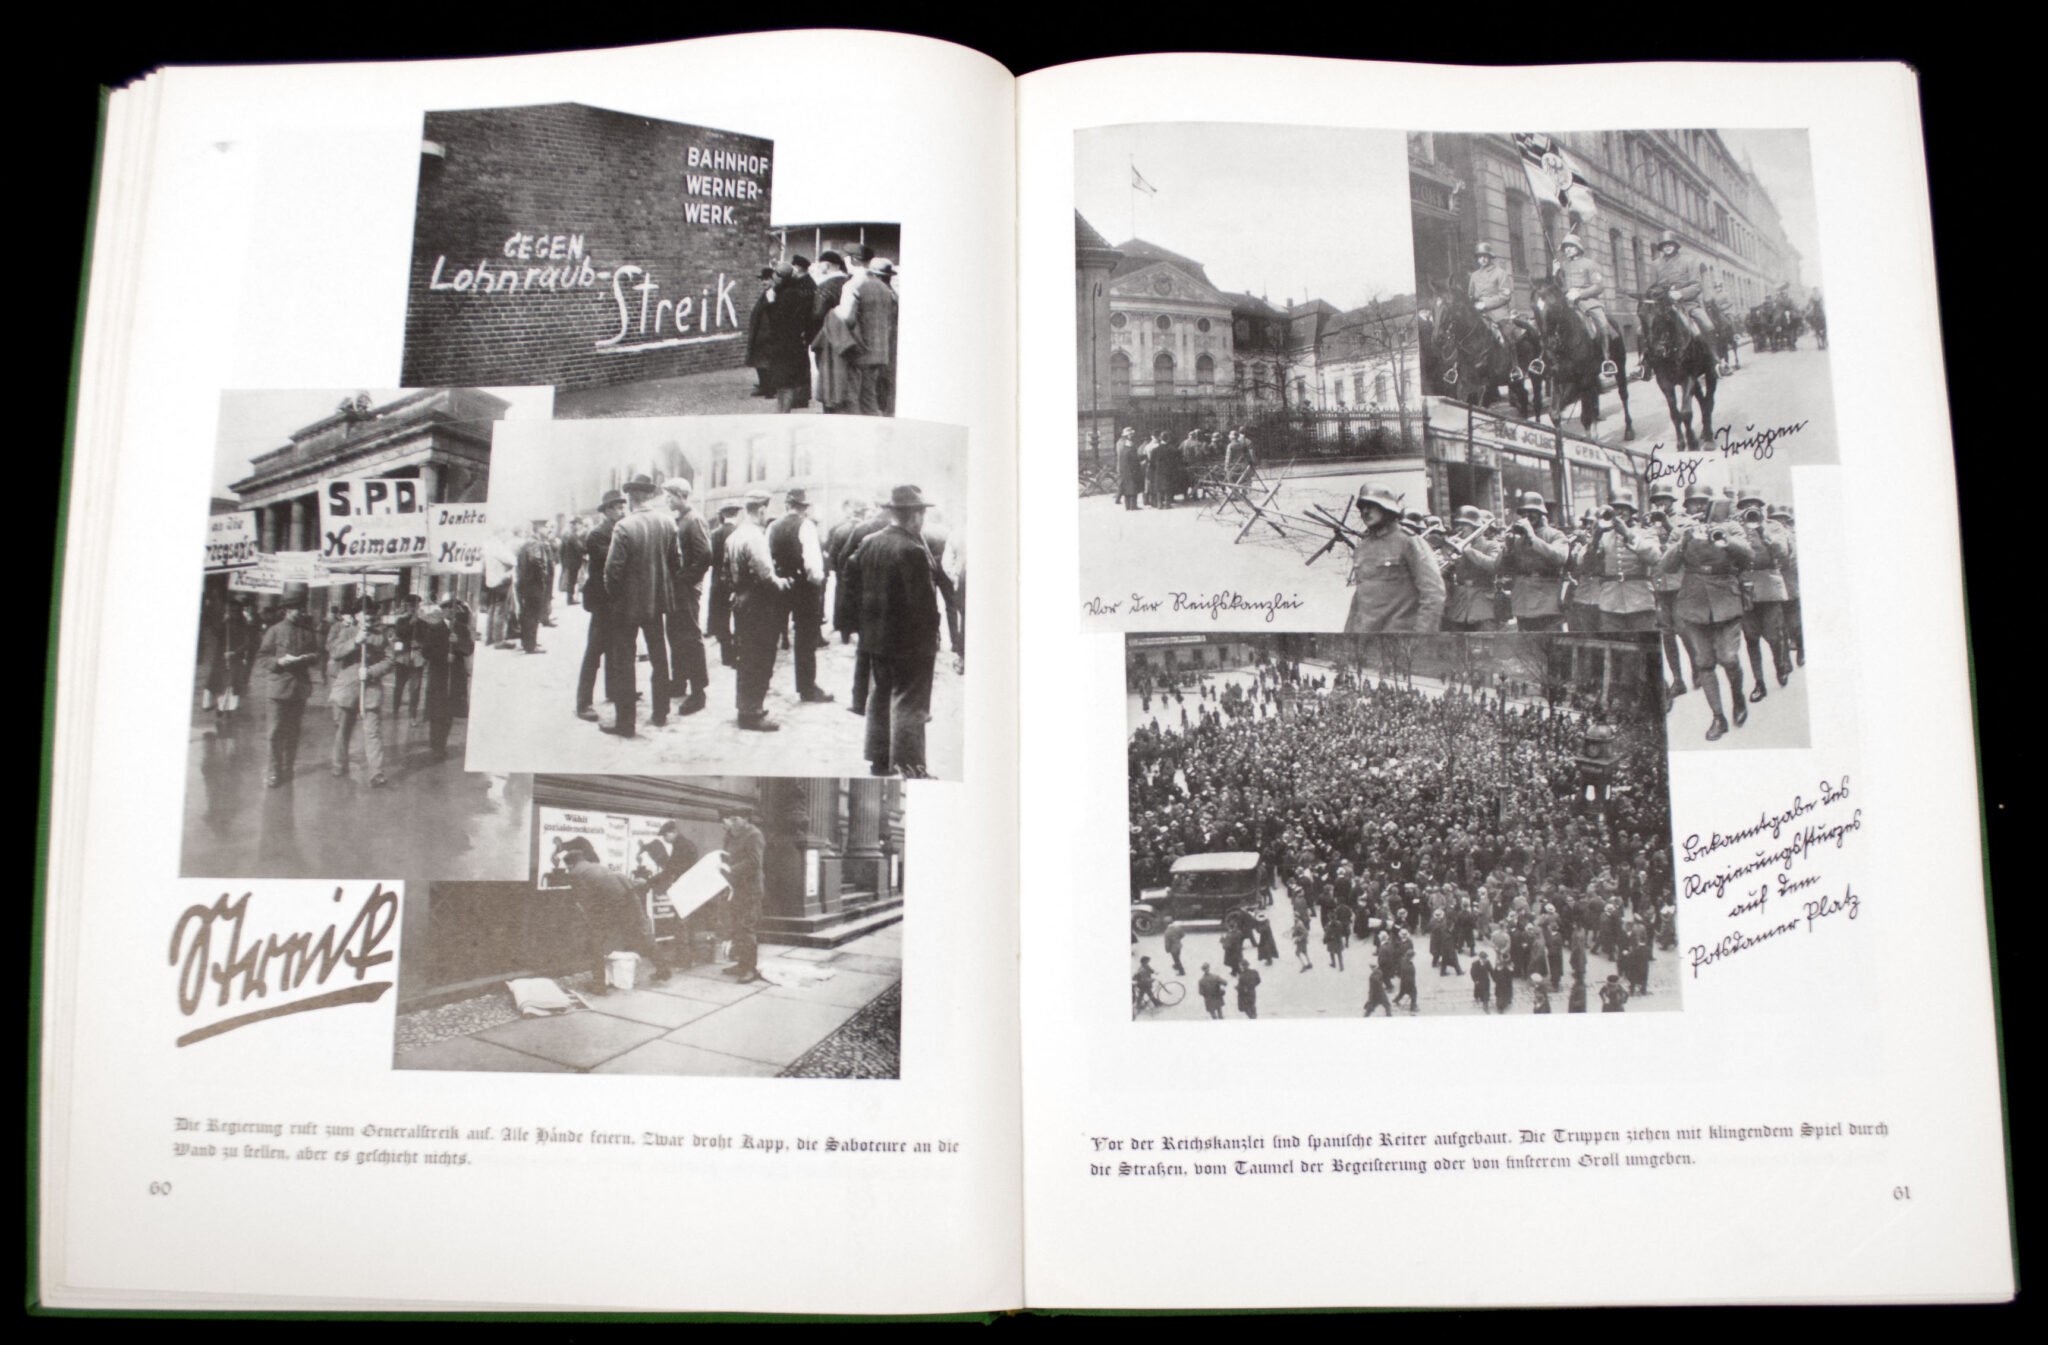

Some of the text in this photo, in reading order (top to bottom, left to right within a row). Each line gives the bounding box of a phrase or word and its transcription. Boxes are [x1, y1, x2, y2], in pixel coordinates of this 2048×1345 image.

[687, 146, 769, 176] BAHNHOF
[685, 174, 764, 201] WERNER-
[683, 201, 738, 226] WERK.
[503, 231, 586, 261] GEGEN
[429, 254, 611, 294] Lohnraub-
[595, 264, 739, 348] Streik
[328, 480, 424, 517] S.P.D.
[438, 508, 477, 526] Denkt
[1083, 596, 1122, 617] Vor
[1128, 592, 1164, 615] der
[1802, 882, 1861, 933] Platz
[175, 1116, 201, 1131] Die
[207, 1118, 283, 1137] Regierung
[289, 1121, 318, 1135] ruft
[324, 1125, 355, 1137] zum
[466, 1126, 495, 1141] auf.
[502, 1126, 529, 1142] Alle
[590, 1129, 636, 1145] feiern.
[692, 1134, 733, 1149] droht
[741, 1133, 790, 1154] Kapp,
[796, 1137, 819, 1152] die
[824, 1135, 907, 1153] Saboteure
[912, 1141, 932, 1153] an
[937, 1139, 959, 1153] die
[1090, 1136, 1125, 1153] Vor
[1130, 1137, 1155, 1151] der
[1161, 1134, 1265, 1152] Reichskanzlei
[1379, 1131, 1428, 1148] Reiter
[1433, 1130, 1512, 1149] aufgebaut.
[1518, 1129, 1546, 1145] Die
[1552, 1128, 1621, 1146] Truppen
[1626, 1127, 1671, 1142] ziehen
[1676, 1128, 1702, 1140] mit
[1708, 1124, 1794, 1142] klingendem
[1800, 1121, 1843, 1141] Spiel
[1848, 1121, 1889, 1136] durch
[173, 1142, 217, 1157] Wand
[223, 1147, 238, 1158] zu
[296, 1146, 328, 1161] aber
[334, 1150, 350, 1162] es
[424, 1151, 473, 1166] nichts.
[1089, 1163, 1112, 1177] die
[1193, 1162, 1228, 1176] vom
[1233, 1159, 1294, 1176] Taumel
[1300, 1160, 1324, 1174] der
[1433, 1157, 1466, 1171] oder
[1471, 1157, 1500, 1170] von
[1577, 1152, 1620, 1168] Groll
[1625, 1151, 1696, 1169] umgeben.
[149, 1181, 172, 1196] 60
[1892, 1185, 1911, 1201] 61
